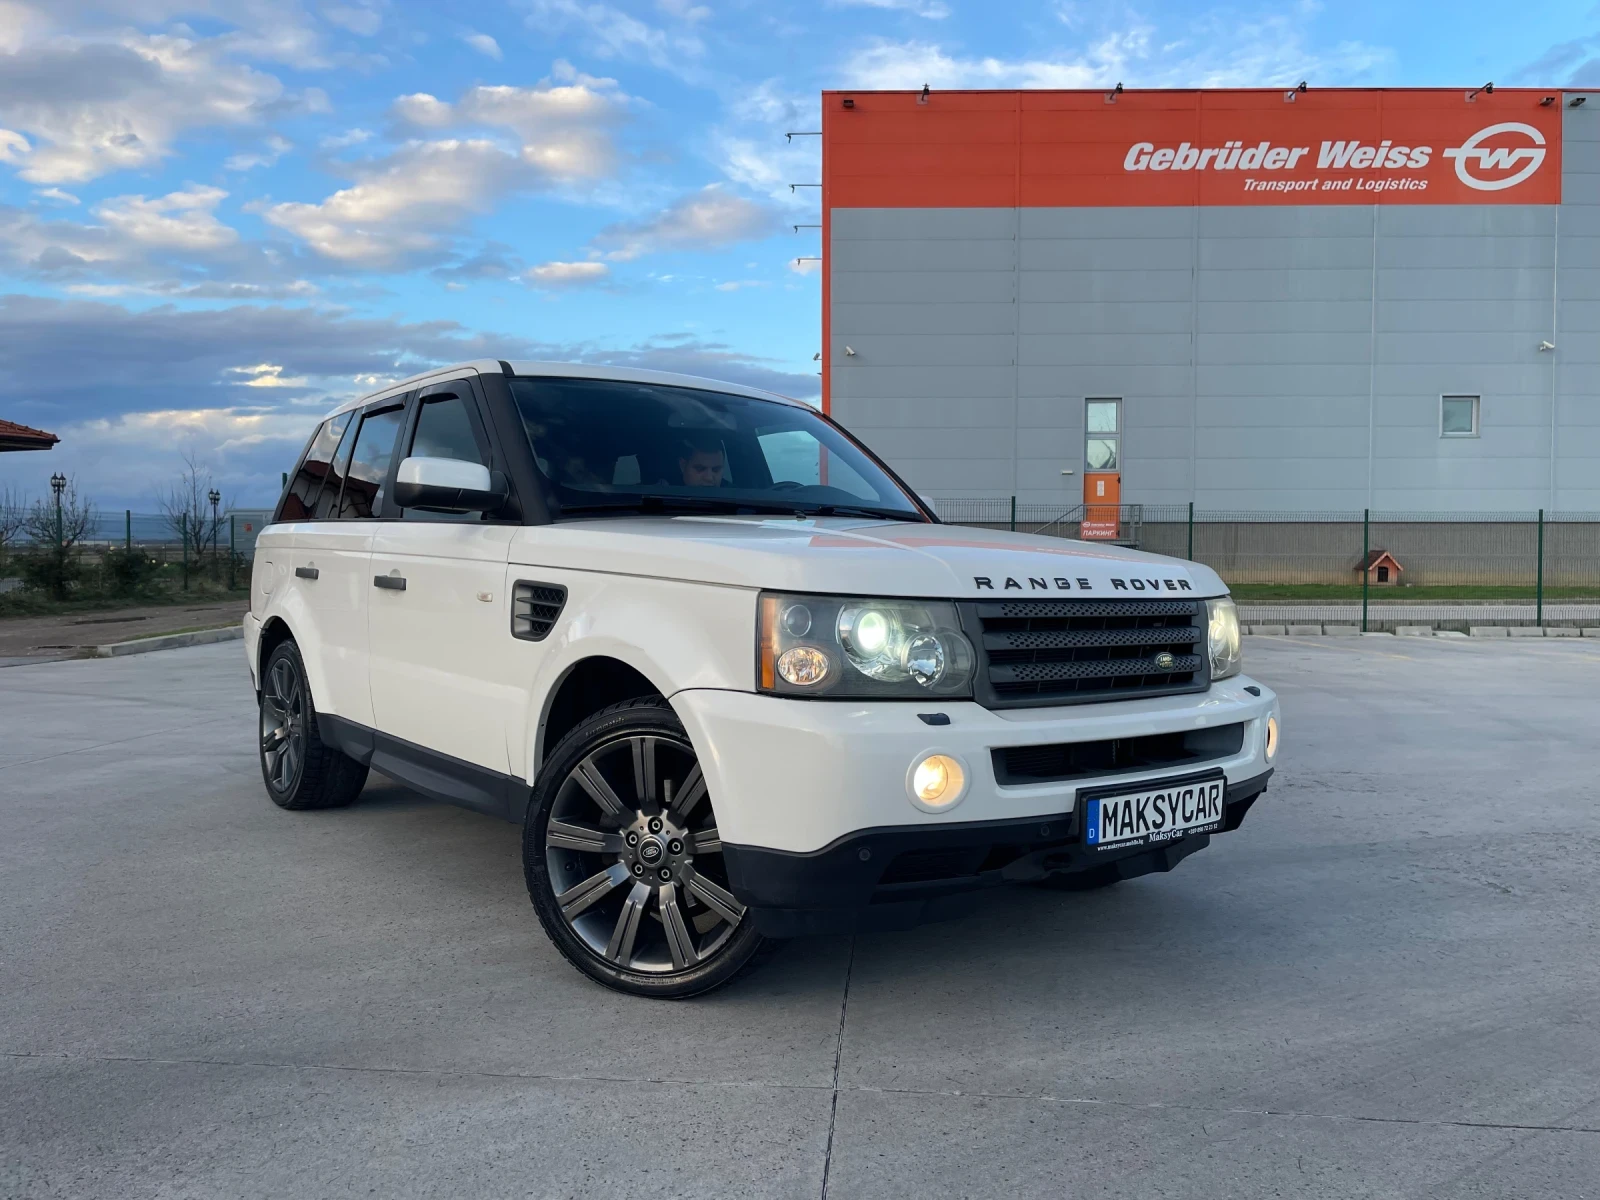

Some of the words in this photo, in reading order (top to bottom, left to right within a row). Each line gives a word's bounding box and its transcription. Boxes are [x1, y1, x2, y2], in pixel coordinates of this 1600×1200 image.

[1123, 140, 1309, 172] Gebrüder
[1316, 140, 1433, 171] Weiss
[1243, 177, 1319, 194] Transport
[1322, 176, 1353, 191] and
[1355, 176, 1428, 194] Logistics
[1083, 529, 1115, 537] ПАРКИНГ
[973, 576, 1093, 591] RANGE
[1110, 578, 1193, 591] ROVER
[1103, 784, 1220, 838] MAKSYCAR
[1089, 828, 1095, 838] D
[1149, 829, 1183, 843] MaksyCar
